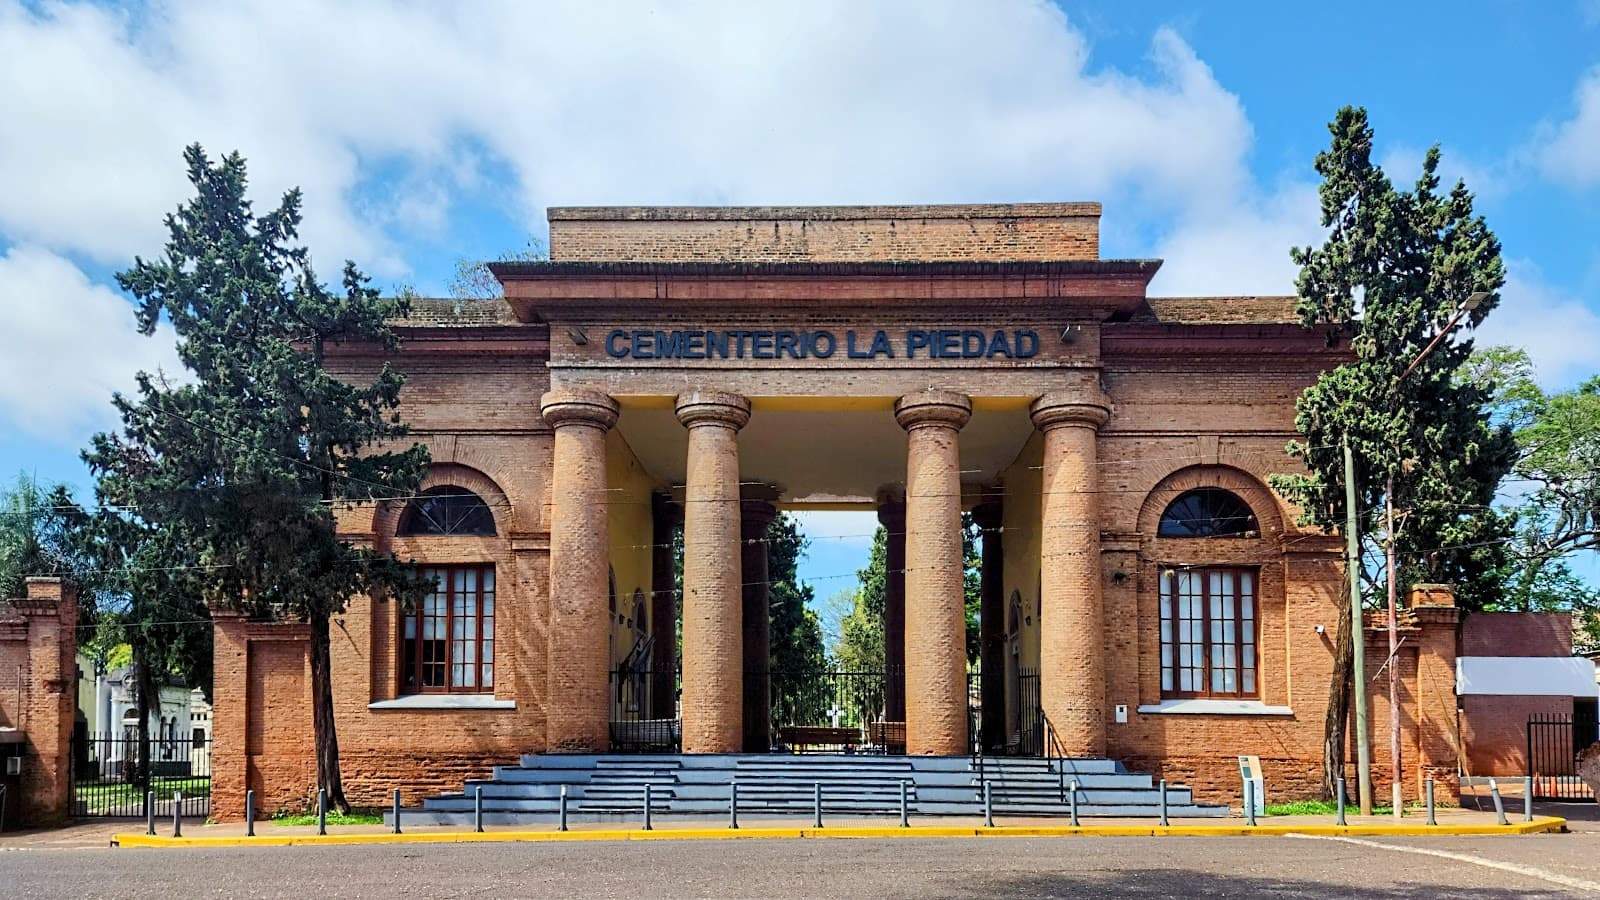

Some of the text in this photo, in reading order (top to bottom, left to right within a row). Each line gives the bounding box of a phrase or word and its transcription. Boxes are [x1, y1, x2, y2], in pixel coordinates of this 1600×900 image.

[605, 328, 1039, 359] CEMENTERIO LA PIEDAD
